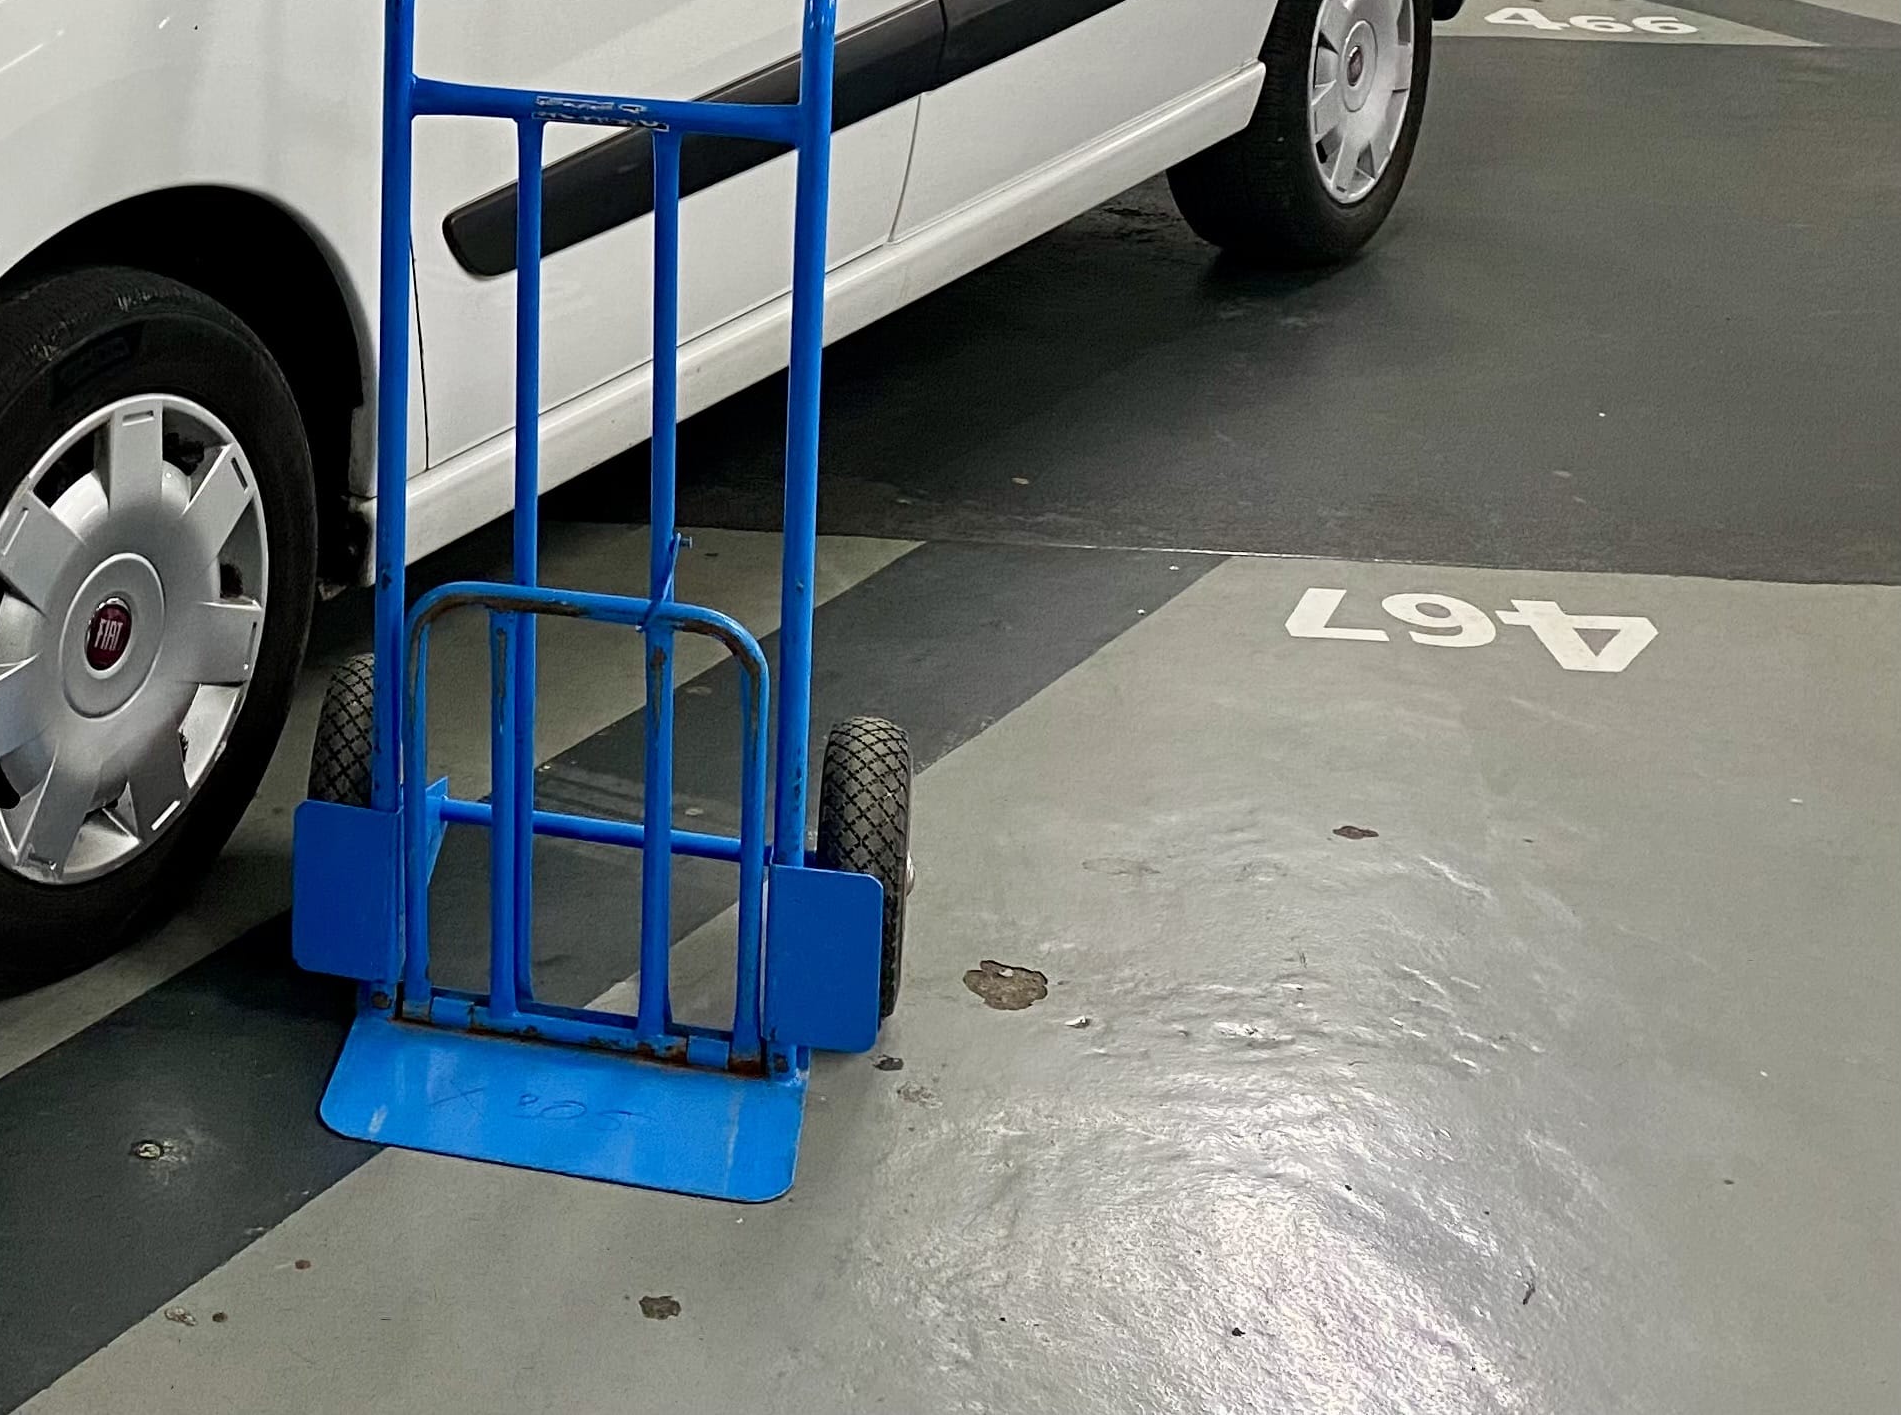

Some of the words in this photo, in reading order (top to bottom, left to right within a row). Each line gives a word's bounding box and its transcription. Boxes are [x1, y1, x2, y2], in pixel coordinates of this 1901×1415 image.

[1484, 7, 1698, 34] 466
[94, 618, 124, 652] FIAT
[1284, 587, 1660, 673] 467
